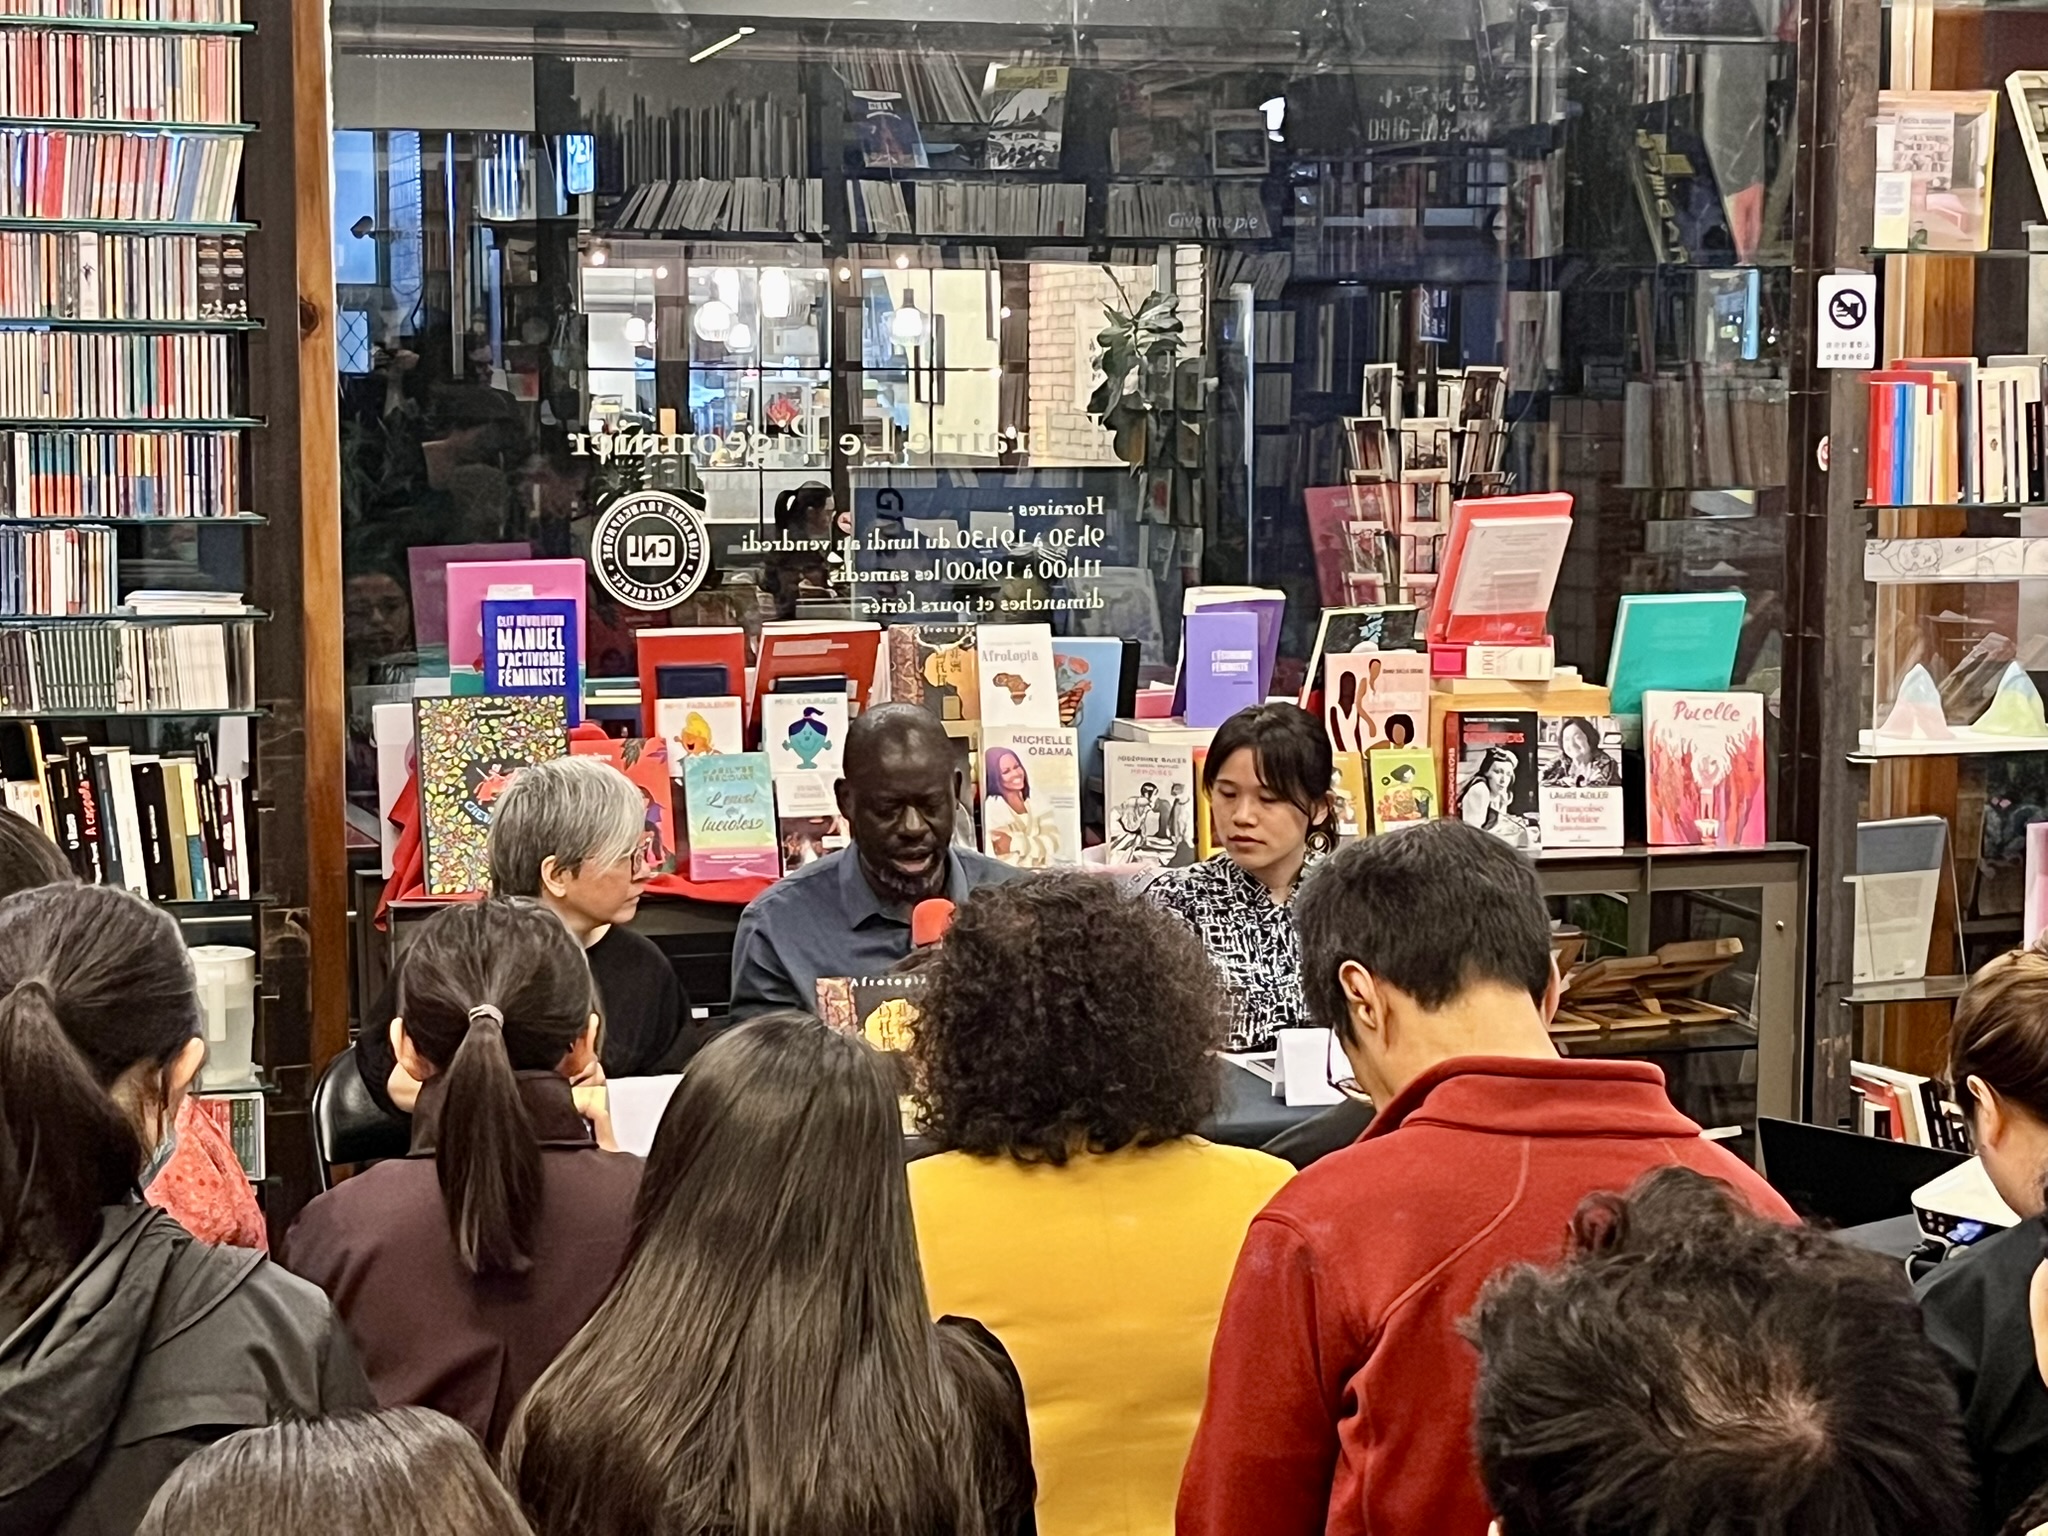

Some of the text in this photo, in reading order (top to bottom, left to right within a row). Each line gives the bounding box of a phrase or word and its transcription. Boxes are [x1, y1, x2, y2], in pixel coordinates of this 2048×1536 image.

[1168, 212, 1259, 233] Give me pie
[497, 627, 565, 650] MANUEL
[497, 651, 565, 668] D'ACTIVISME
[981, 649, 1039, 663] Afrotopia
[498, 667, 566, 687] FÉMINISTE
[1673, 700, 1741, 722] Pucelle
[1012, 735, 1073, 745] MICHELLE
[1028, 746, 1073, 757] OBAMA
[1579, 790, 1609, 800] ADLER
